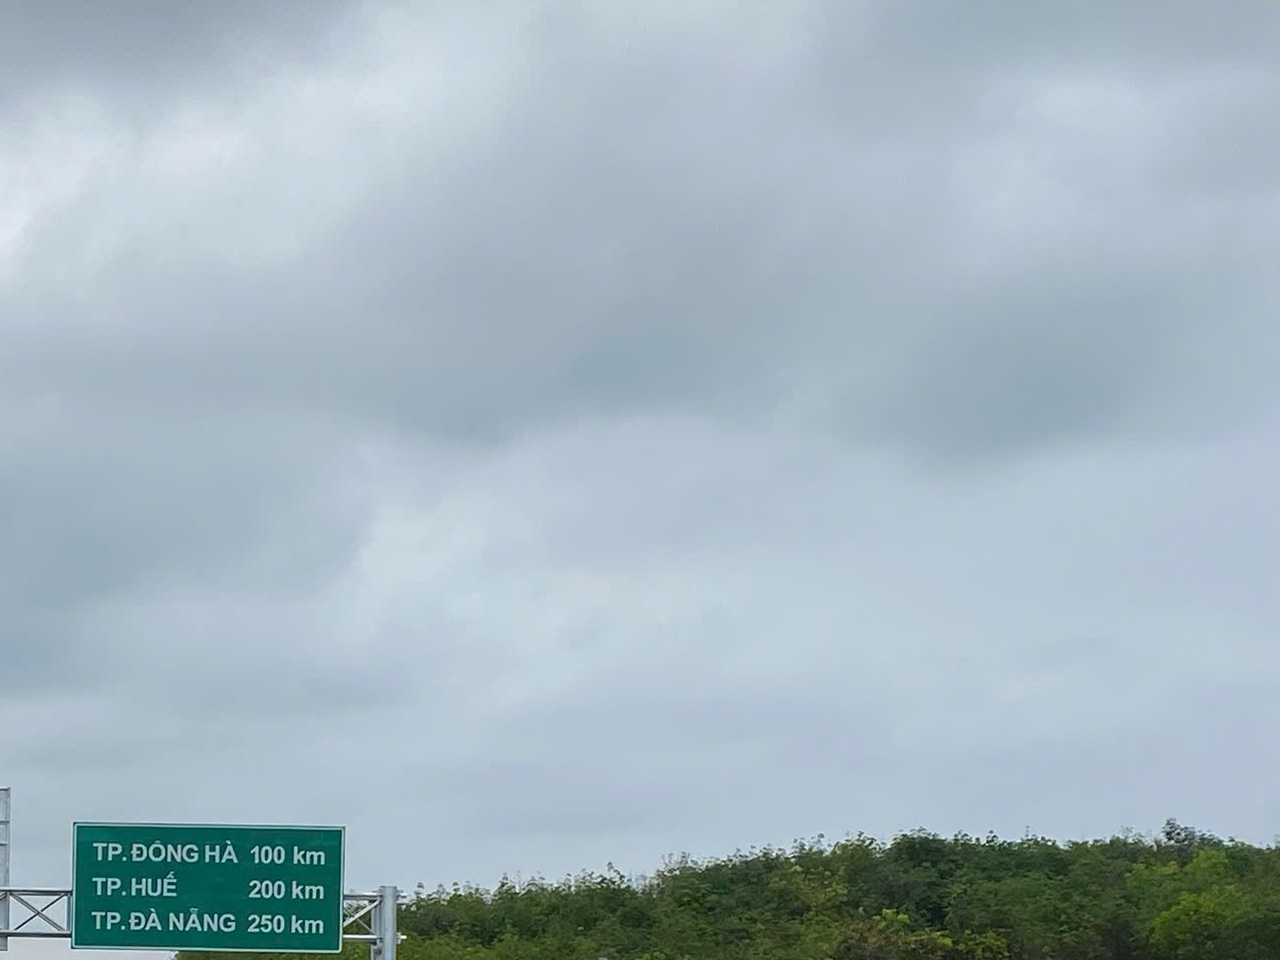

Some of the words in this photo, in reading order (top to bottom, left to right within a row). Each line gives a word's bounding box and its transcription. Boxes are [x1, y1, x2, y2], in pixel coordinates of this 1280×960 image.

[205, 840, 238, 863] HÀ
[251, 845, 285, 865] 100
[293, 846, 325, 865] km
[248, 880, 285, 899] 200
[292, 880, 324, 900] km
[169, 908, 236, 932] NẴNG
[247, 914, 285, 933] 250
[291, 915, 324, 934] km
